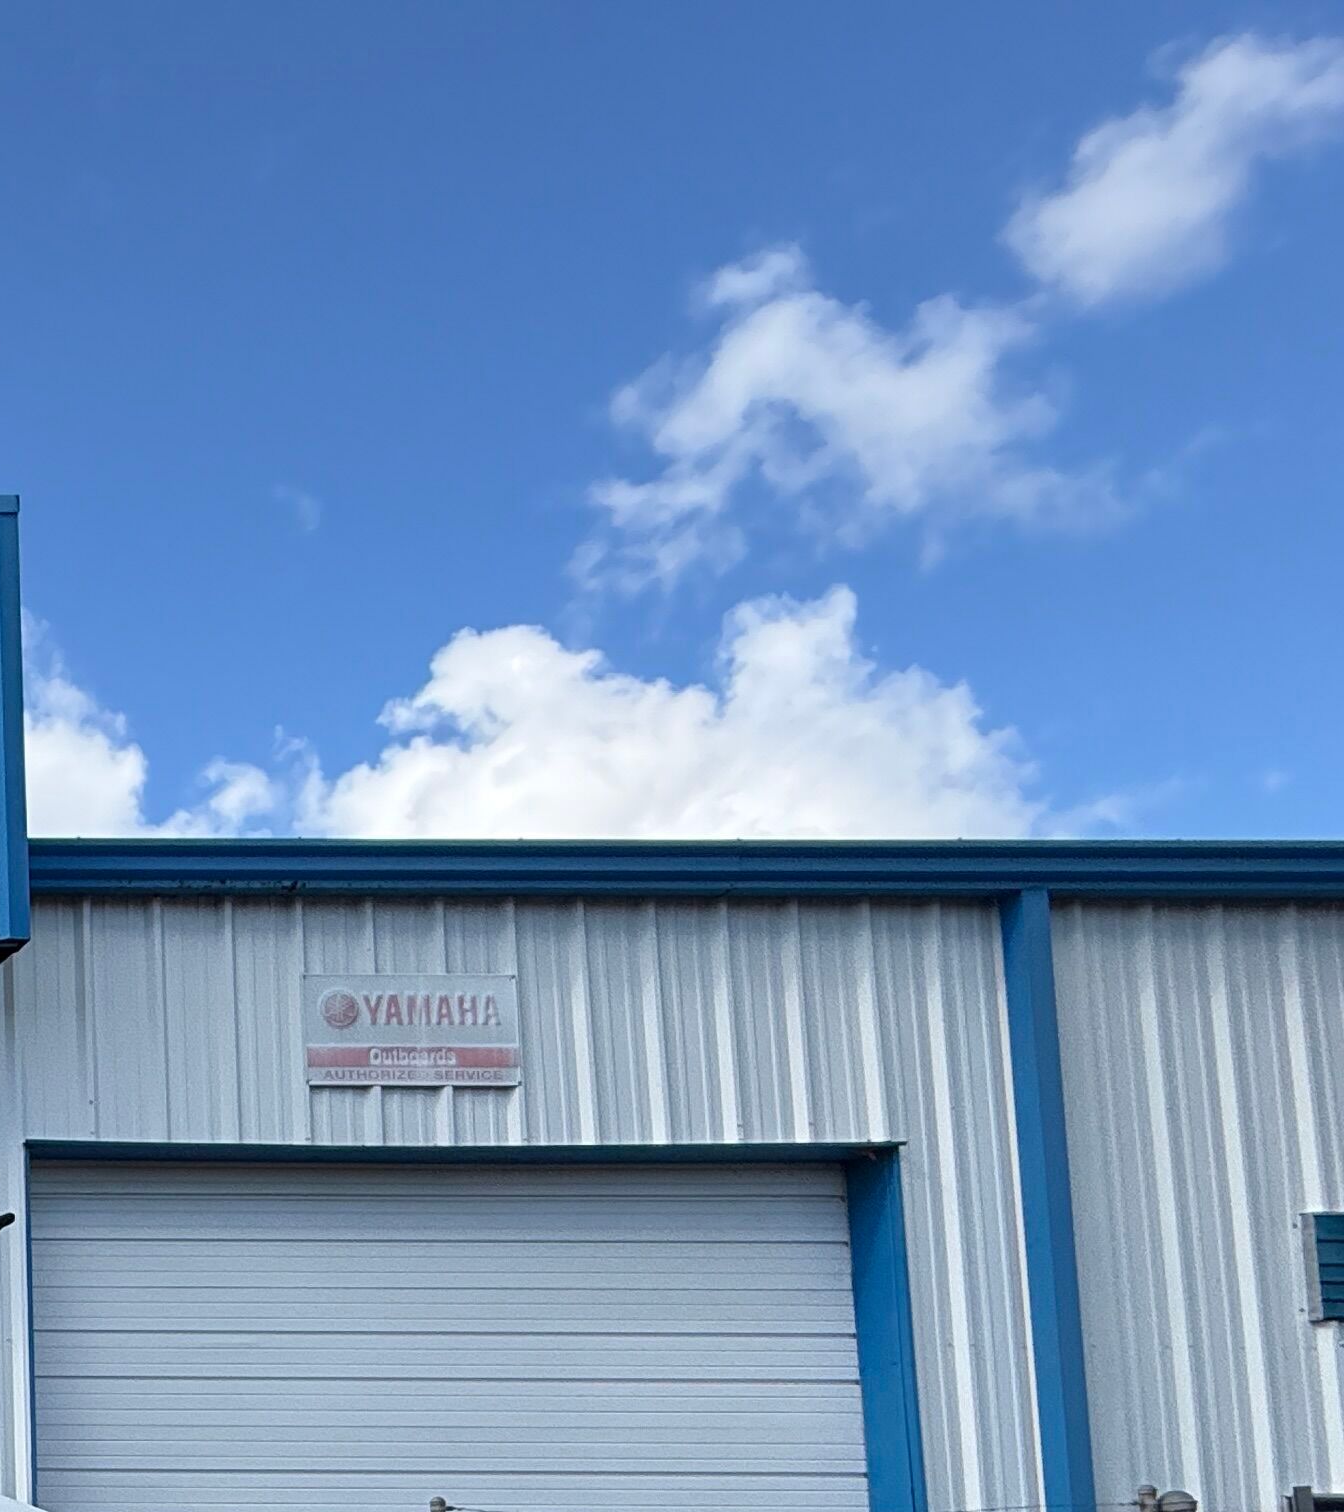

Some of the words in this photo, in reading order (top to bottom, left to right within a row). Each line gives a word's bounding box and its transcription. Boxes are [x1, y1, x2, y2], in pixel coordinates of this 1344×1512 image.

[363, 993, 502, 1027] YAMAHA
[323, 1069, 429, 1081] AUTHORIZE
[433, 1069, 504, 1081] SERVICE
